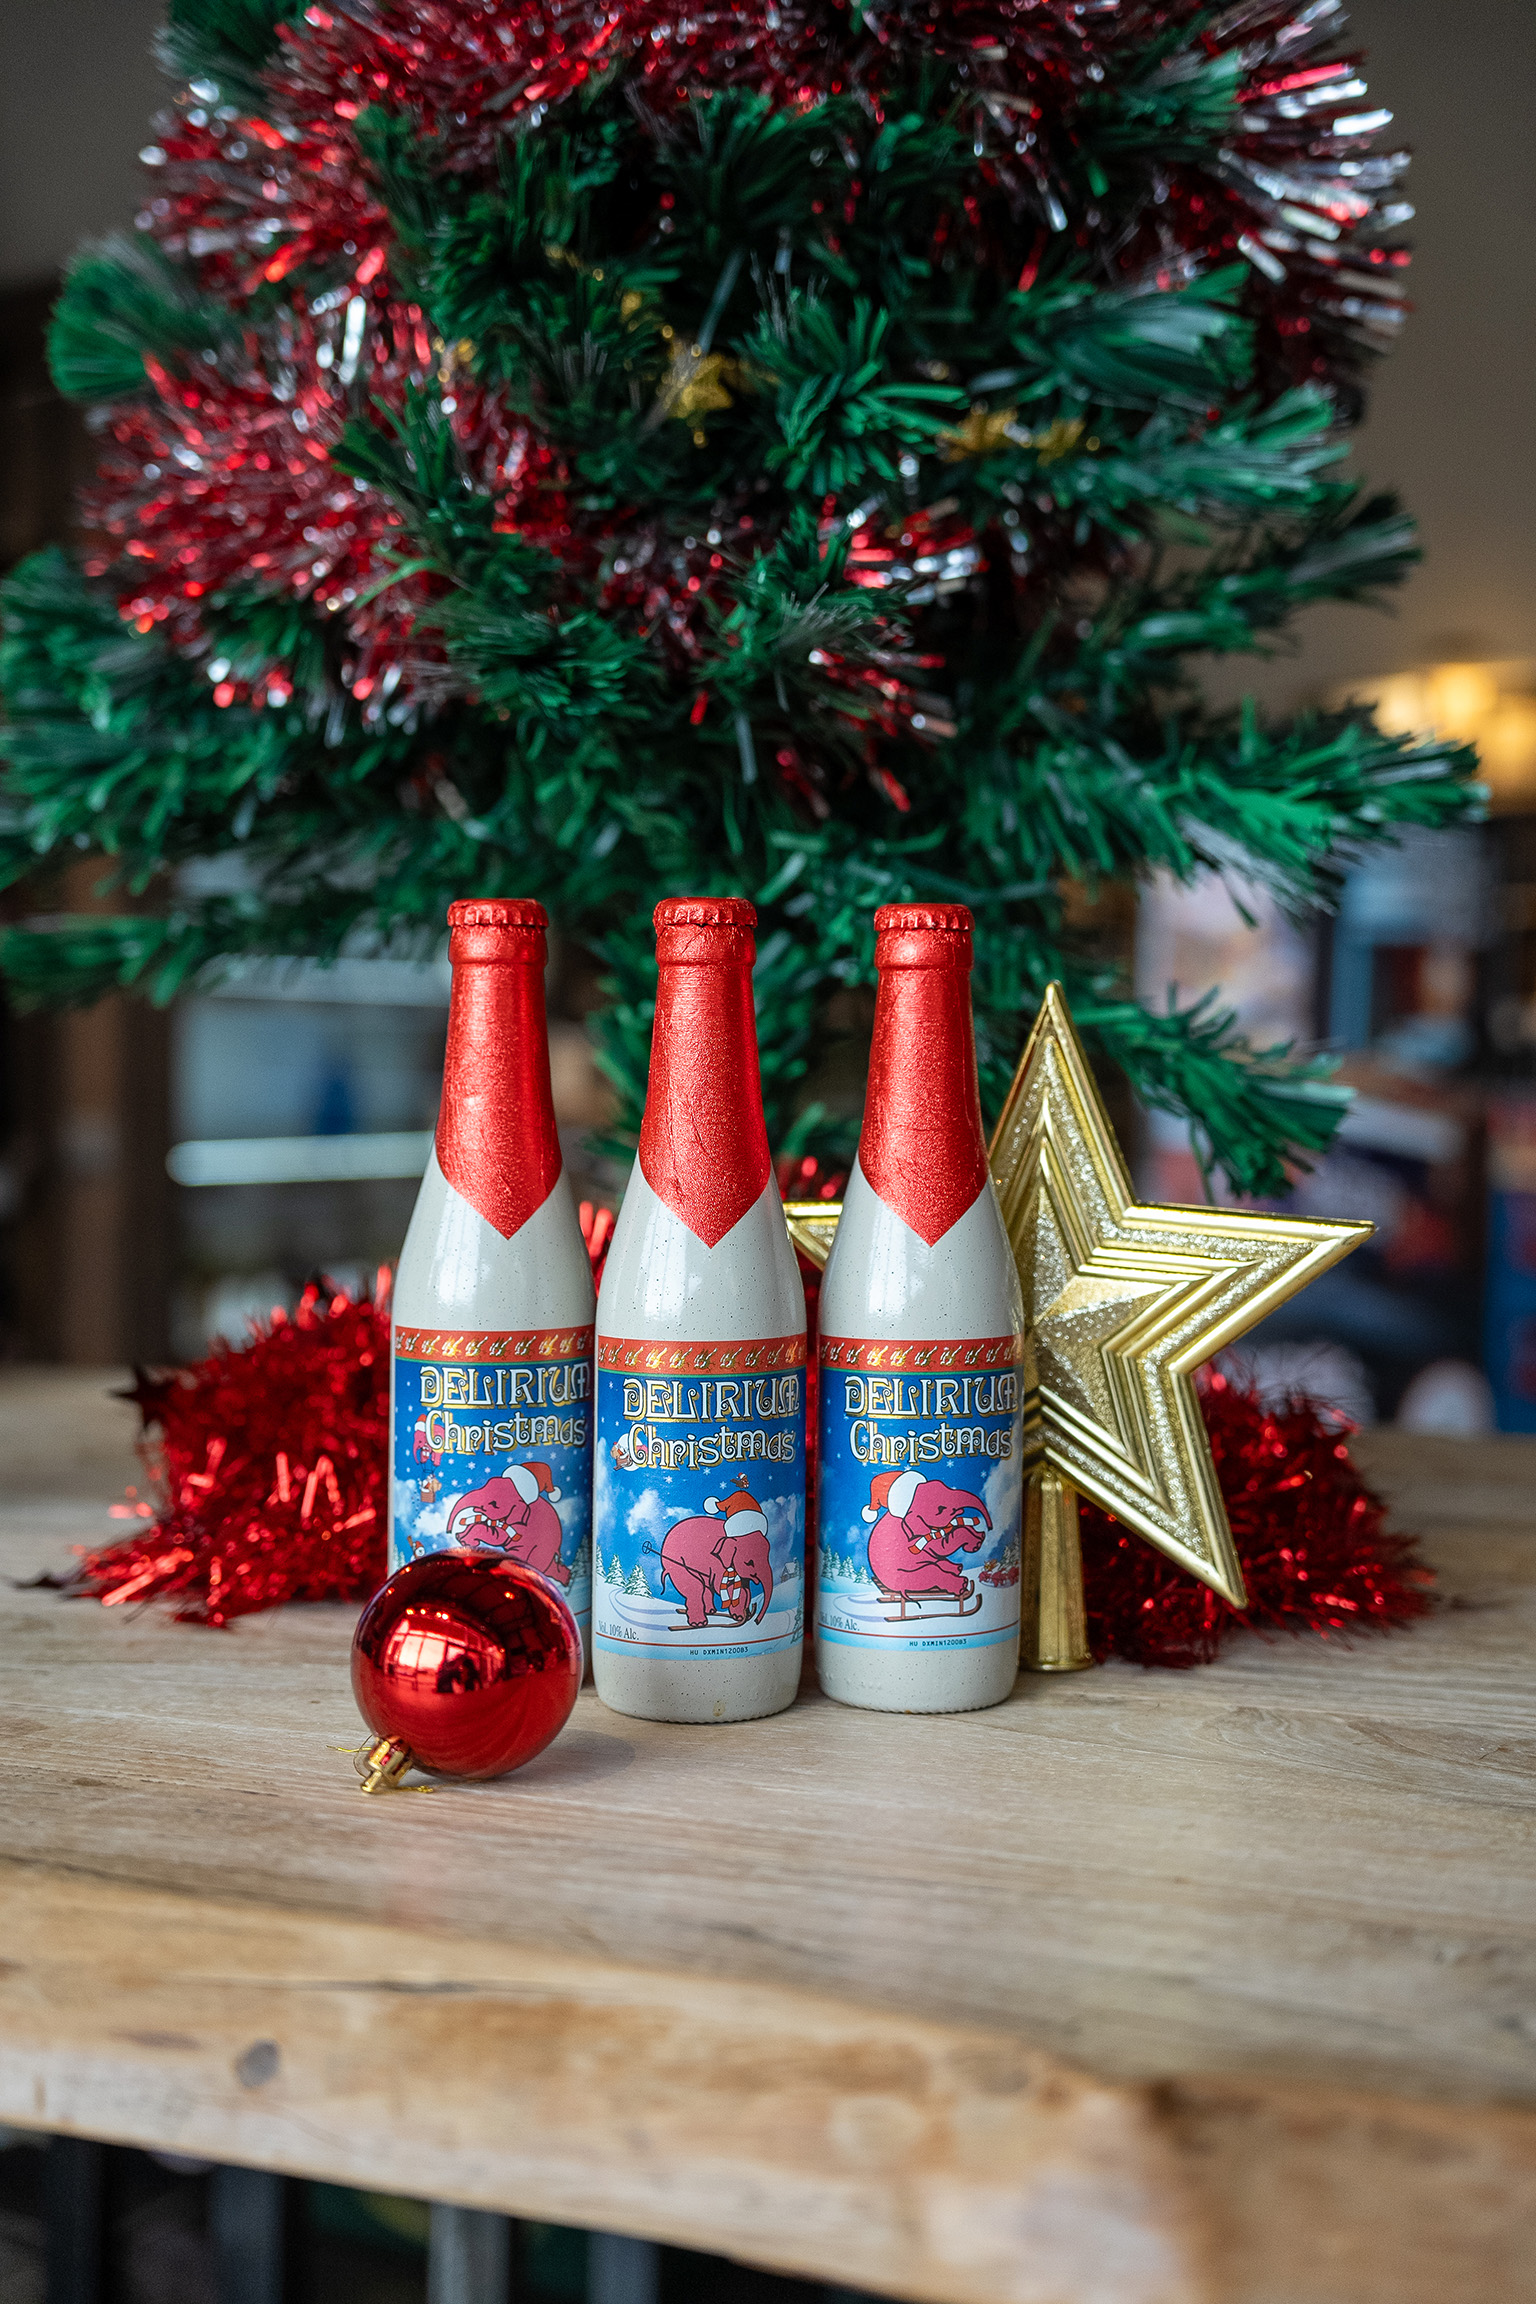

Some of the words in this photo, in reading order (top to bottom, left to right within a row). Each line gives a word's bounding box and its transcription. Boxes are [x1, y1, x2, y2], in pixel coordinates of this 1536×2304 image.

[420, 1365, 591, 1409] DELIRIUM
[622, 1375, 800, 1423] DELIRIUM
[844, 1372, 1018, 1420] DELIRIUM
[425, 1409, 587, 1455] Christmas
[627, 1422, 796, 1471] Christmas
[850, 1419, 1017, 1467] Christmas
[609, 1623, 622, 1638] 10%
[623, 1627, 640, 1641] Alc.
[830, 1615, 843, 1629] 10%
[844, 1618, 860, 1632] Alc.
